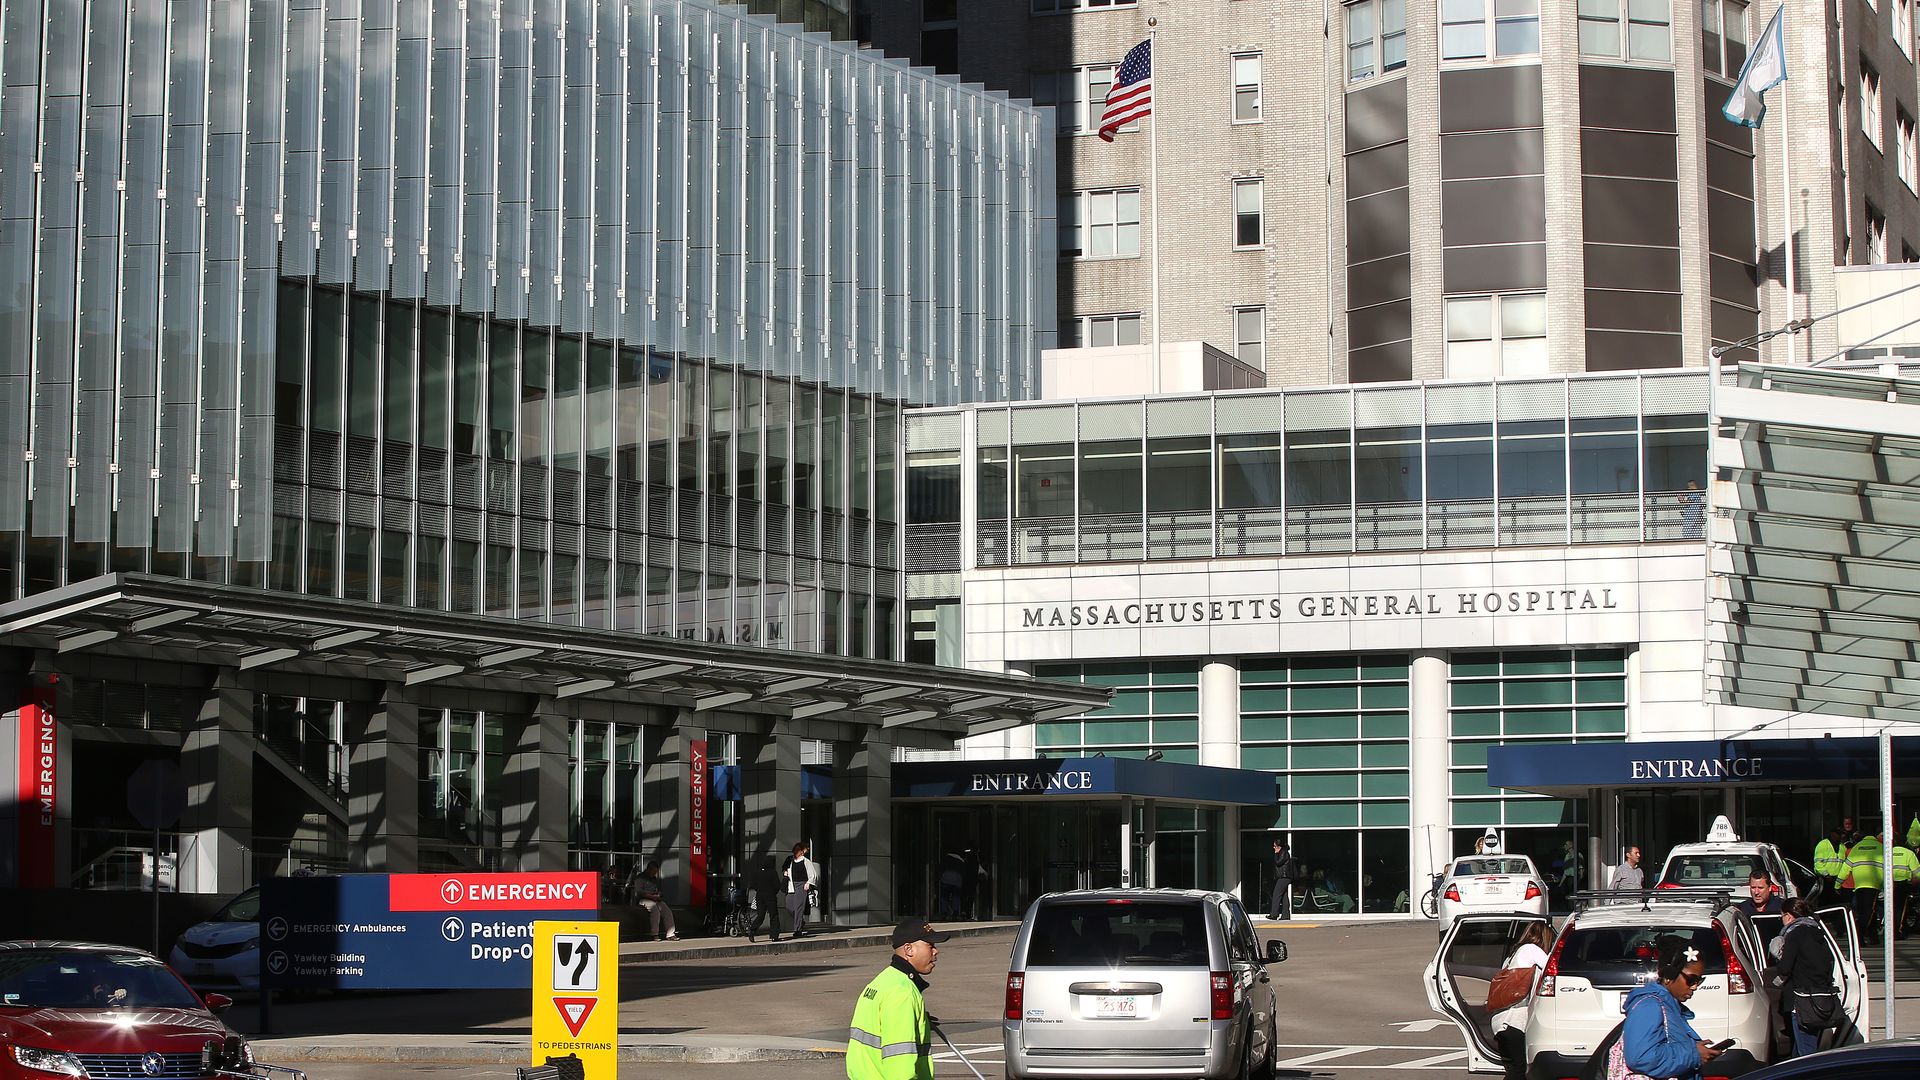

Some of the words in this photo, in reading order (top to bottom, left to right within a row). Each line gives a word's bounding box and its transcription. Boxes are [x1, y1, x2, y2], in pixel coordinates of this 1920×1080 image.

[1022, 599, 1281, 628] MASSACHUSETTS
[1298, 594, 1442, 617] GENERAL
[1458, 588, 1618, 613] HOSPITAL
[41, 699, 54, 827] EMERGENCY
[1630, 758, 1764, 779] ENTRANCE
[971, 771, 1093, 791] ENTRANCE
[693, 750, 702, 855] EMERGENCY
[468, 883, 588, 901] EMERGENCY
[293, 924, 350, 933] EMERGENCY
[353, 923, 407, 933] Ambulances
[470, 920, 534, 938] Patient
[294, 954, 328, 964] Yawkey
[330, 953, 366, 964] Building
[470, 942, 533, 963] Drop-O
[294, 966, 328, 976] Yawkey
[330, 966, 364, 977] Parking
[552, 1042, 612, 1050] PEDESTRIANS
